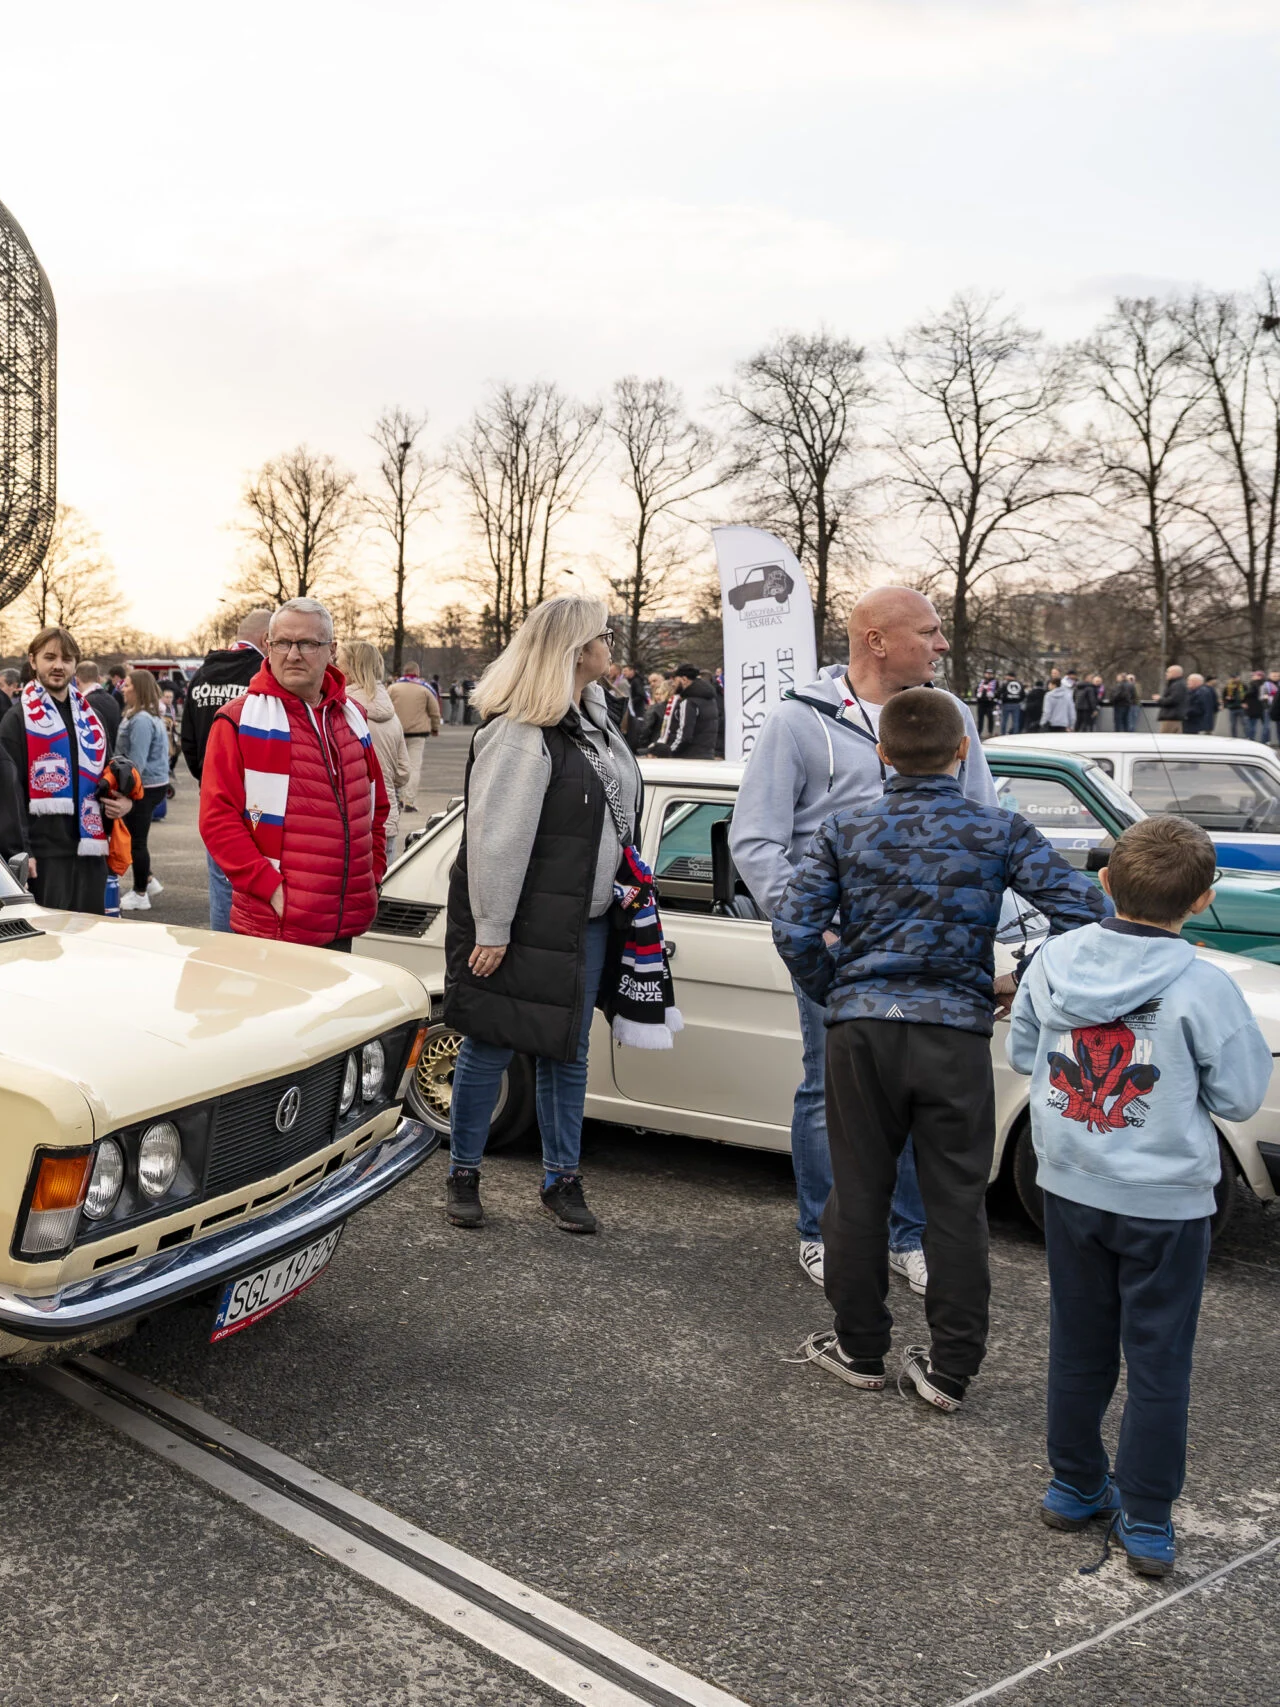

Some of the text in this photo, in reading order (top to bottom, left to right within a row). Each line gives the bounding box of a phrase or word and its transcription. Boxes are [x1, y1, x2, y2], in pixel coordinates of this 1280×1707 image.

[1027, 804, 1079, 815] GerarD
[618, 983, 663, 1002] ZABRZE
[229, 1269, 271, 1320] SGL
